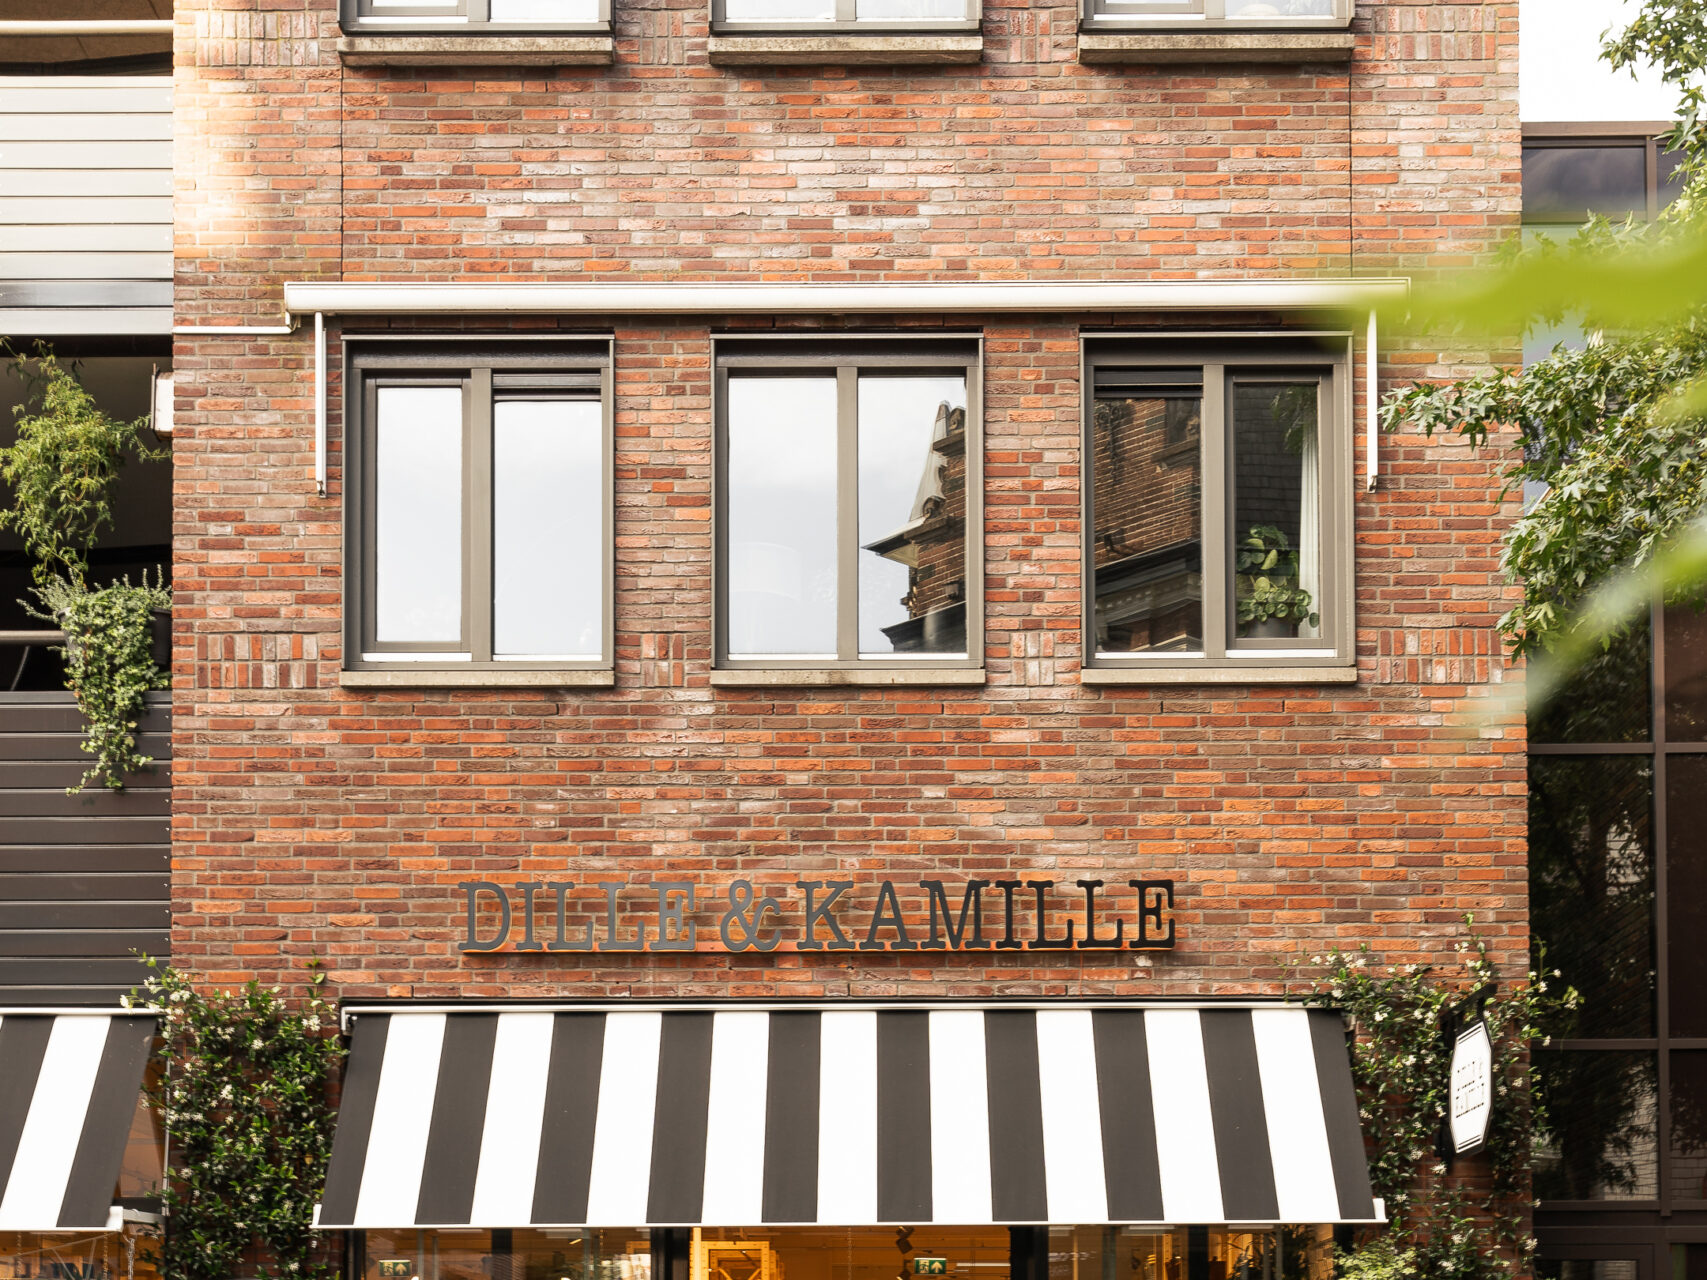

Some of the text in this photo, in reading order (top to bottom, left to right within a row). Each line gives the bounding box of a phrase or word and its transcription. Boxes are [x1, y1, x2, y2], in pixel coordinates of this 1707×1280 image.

[458, 879, 1175, 952] DILLE & KAMILLE
